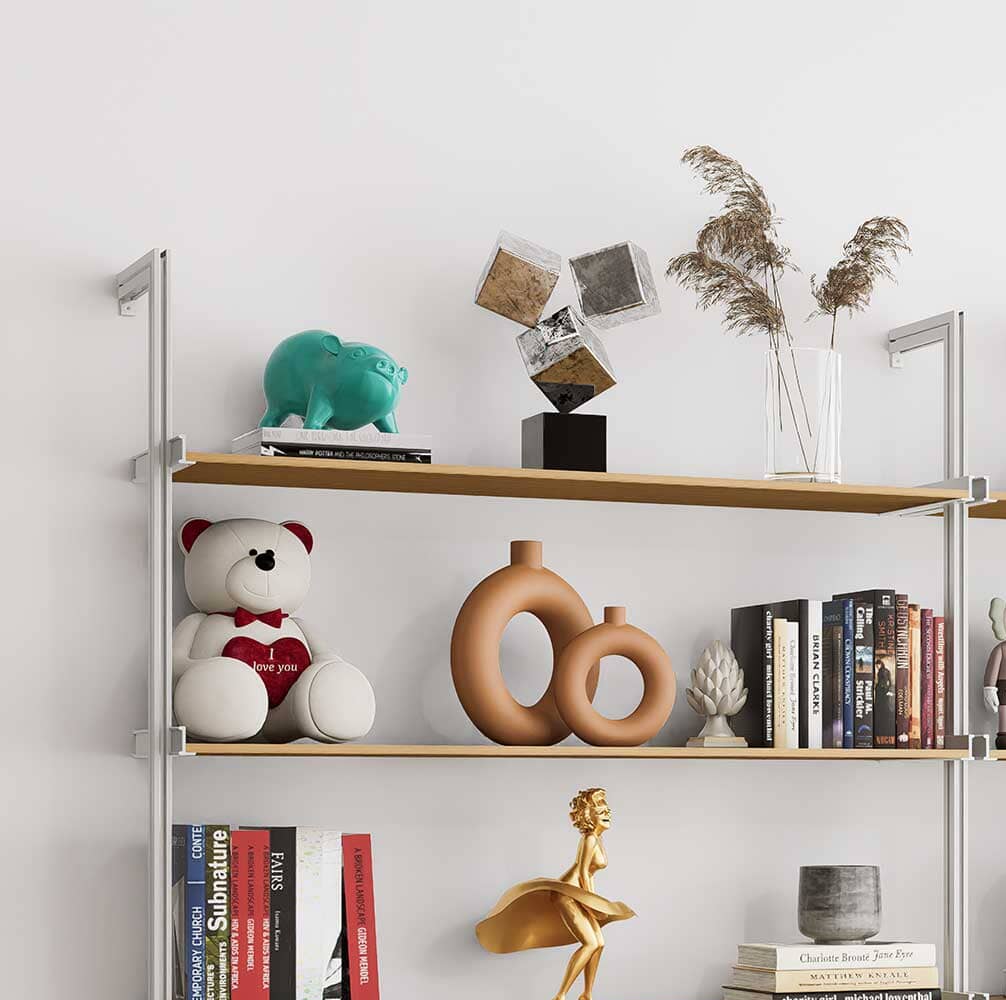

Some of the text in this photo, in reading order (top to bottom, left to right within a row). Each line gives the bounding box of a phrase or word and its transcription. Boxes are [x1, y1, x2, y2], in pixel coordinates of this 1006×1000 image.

[855, 606, 865, 640] Calling
[253, 661, 298, 674] love you
[269, 648, 274, 660] I
[812, 634, 820, 715] BRIAN CLARKE
[856, 680, 864, 719] Strickler
[865, 680, 873, 714] Paul M.
[207, 829, 228, 931] Subnature
[272, 852, 284, 891] FAIRS
[355, 854, 364, 884] BROKEN
[356, 884, 366, 926] LANDSCAPE
[192, 906, 202, 946] CHURCH
[358, 927, 368, 955] GIDEON
[360, 956, 370, 985] MENDEL
[799, 952, 840, 964] Charlotte
[872, 950, 894, 962] Jane
[894, 950, 914, 960] Eyre
